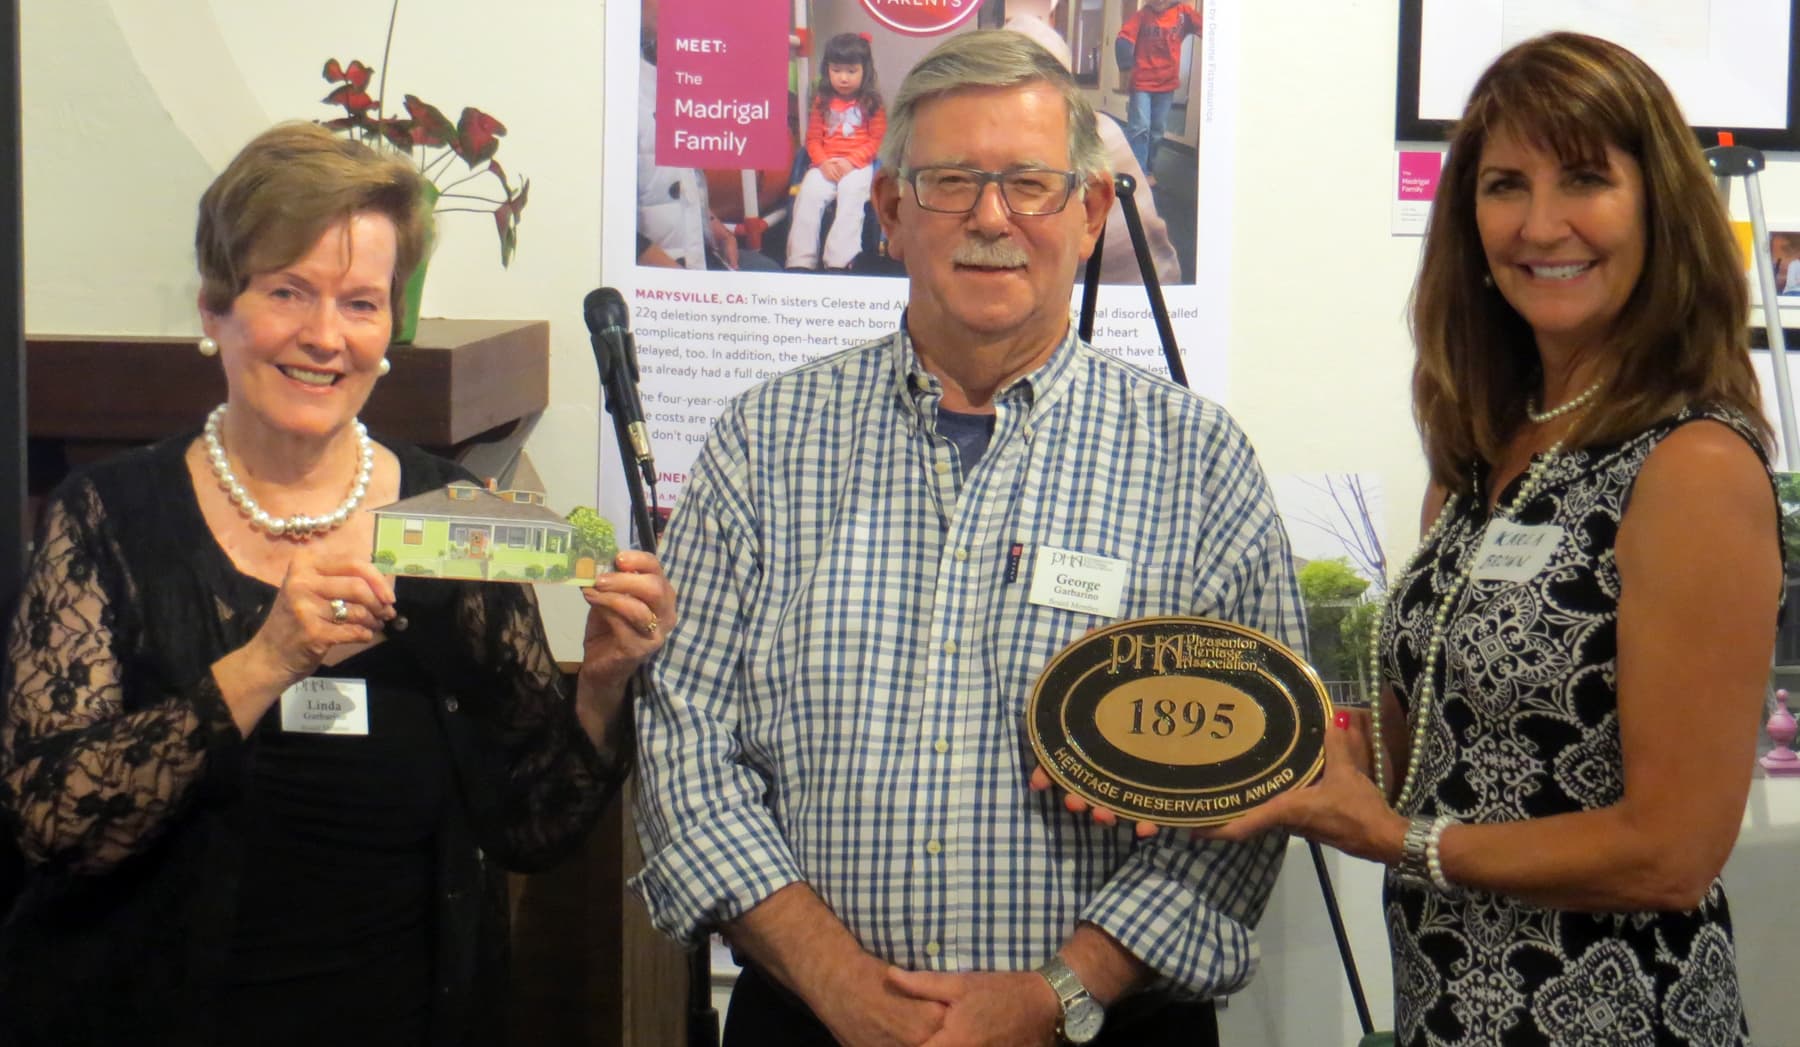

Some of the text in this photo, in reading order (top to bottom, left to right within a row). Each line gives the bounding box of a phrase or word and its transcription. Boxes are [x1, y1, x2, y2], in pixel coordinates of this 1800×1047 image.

[675, 38, 727, 53] MEET:
[675, 71, 703, 85] The
[675, 98, 769, 125] Madrigal
[674, 130, 747, 156] Family
[635, 288, 722, 304] MARYSVILLE,
[726, 294, 748, 305] CA:
[752, 294, 777, 306] Twin
[781, 296, 818, 308] sisters
[821, 297, 866, 310] Celeste
[869, 299, 890, 311] and
[635, 306, 896, 330] 22q deletion syndrome. They were each born
[1111, 307, 1154, 319] disorde
[1168, 307, 1198, 319] alled
[635, 327, 714, 341] complications
[718, 333, 769, 345] requiring
[773, 334, 838, 346] open-heart
[1107, 327, 1138, 338] heart
[686, 348, 708, 359] too.
[712, 348, 721, 359] In
[725, 349, 776, 362] addition,
[779, 352, 798, 362] the
[1126, 346, 1157, 357] have
[639, 365, 653, 374] as
[656, 364, 697, 379] already
[701, 366, 721, 378] had
[725, 369, 731, 378] a
[734, 367, 752, 379] full
[640, 391, 729, 407] he four-year-ol
[655, 413, 685, 424] costs
[688, 416, 706, 424] are
[652, 428, 680, 441] don't
[1056, 573, 1101, 592] George
[1054, 585, 1099, 601] Garbarino
[1107, 633, 1257, 675] PHA Pleasanton
[1187, 645, 1243, 661] Heritage
[1183, 656, 1258, 671] Association
[308, 700, 342, 712] Linda
[1127, 697, 1237, 740] 1895
[1053, 747, 1295, 812] HERITAGE PRESERVATION AWARD
